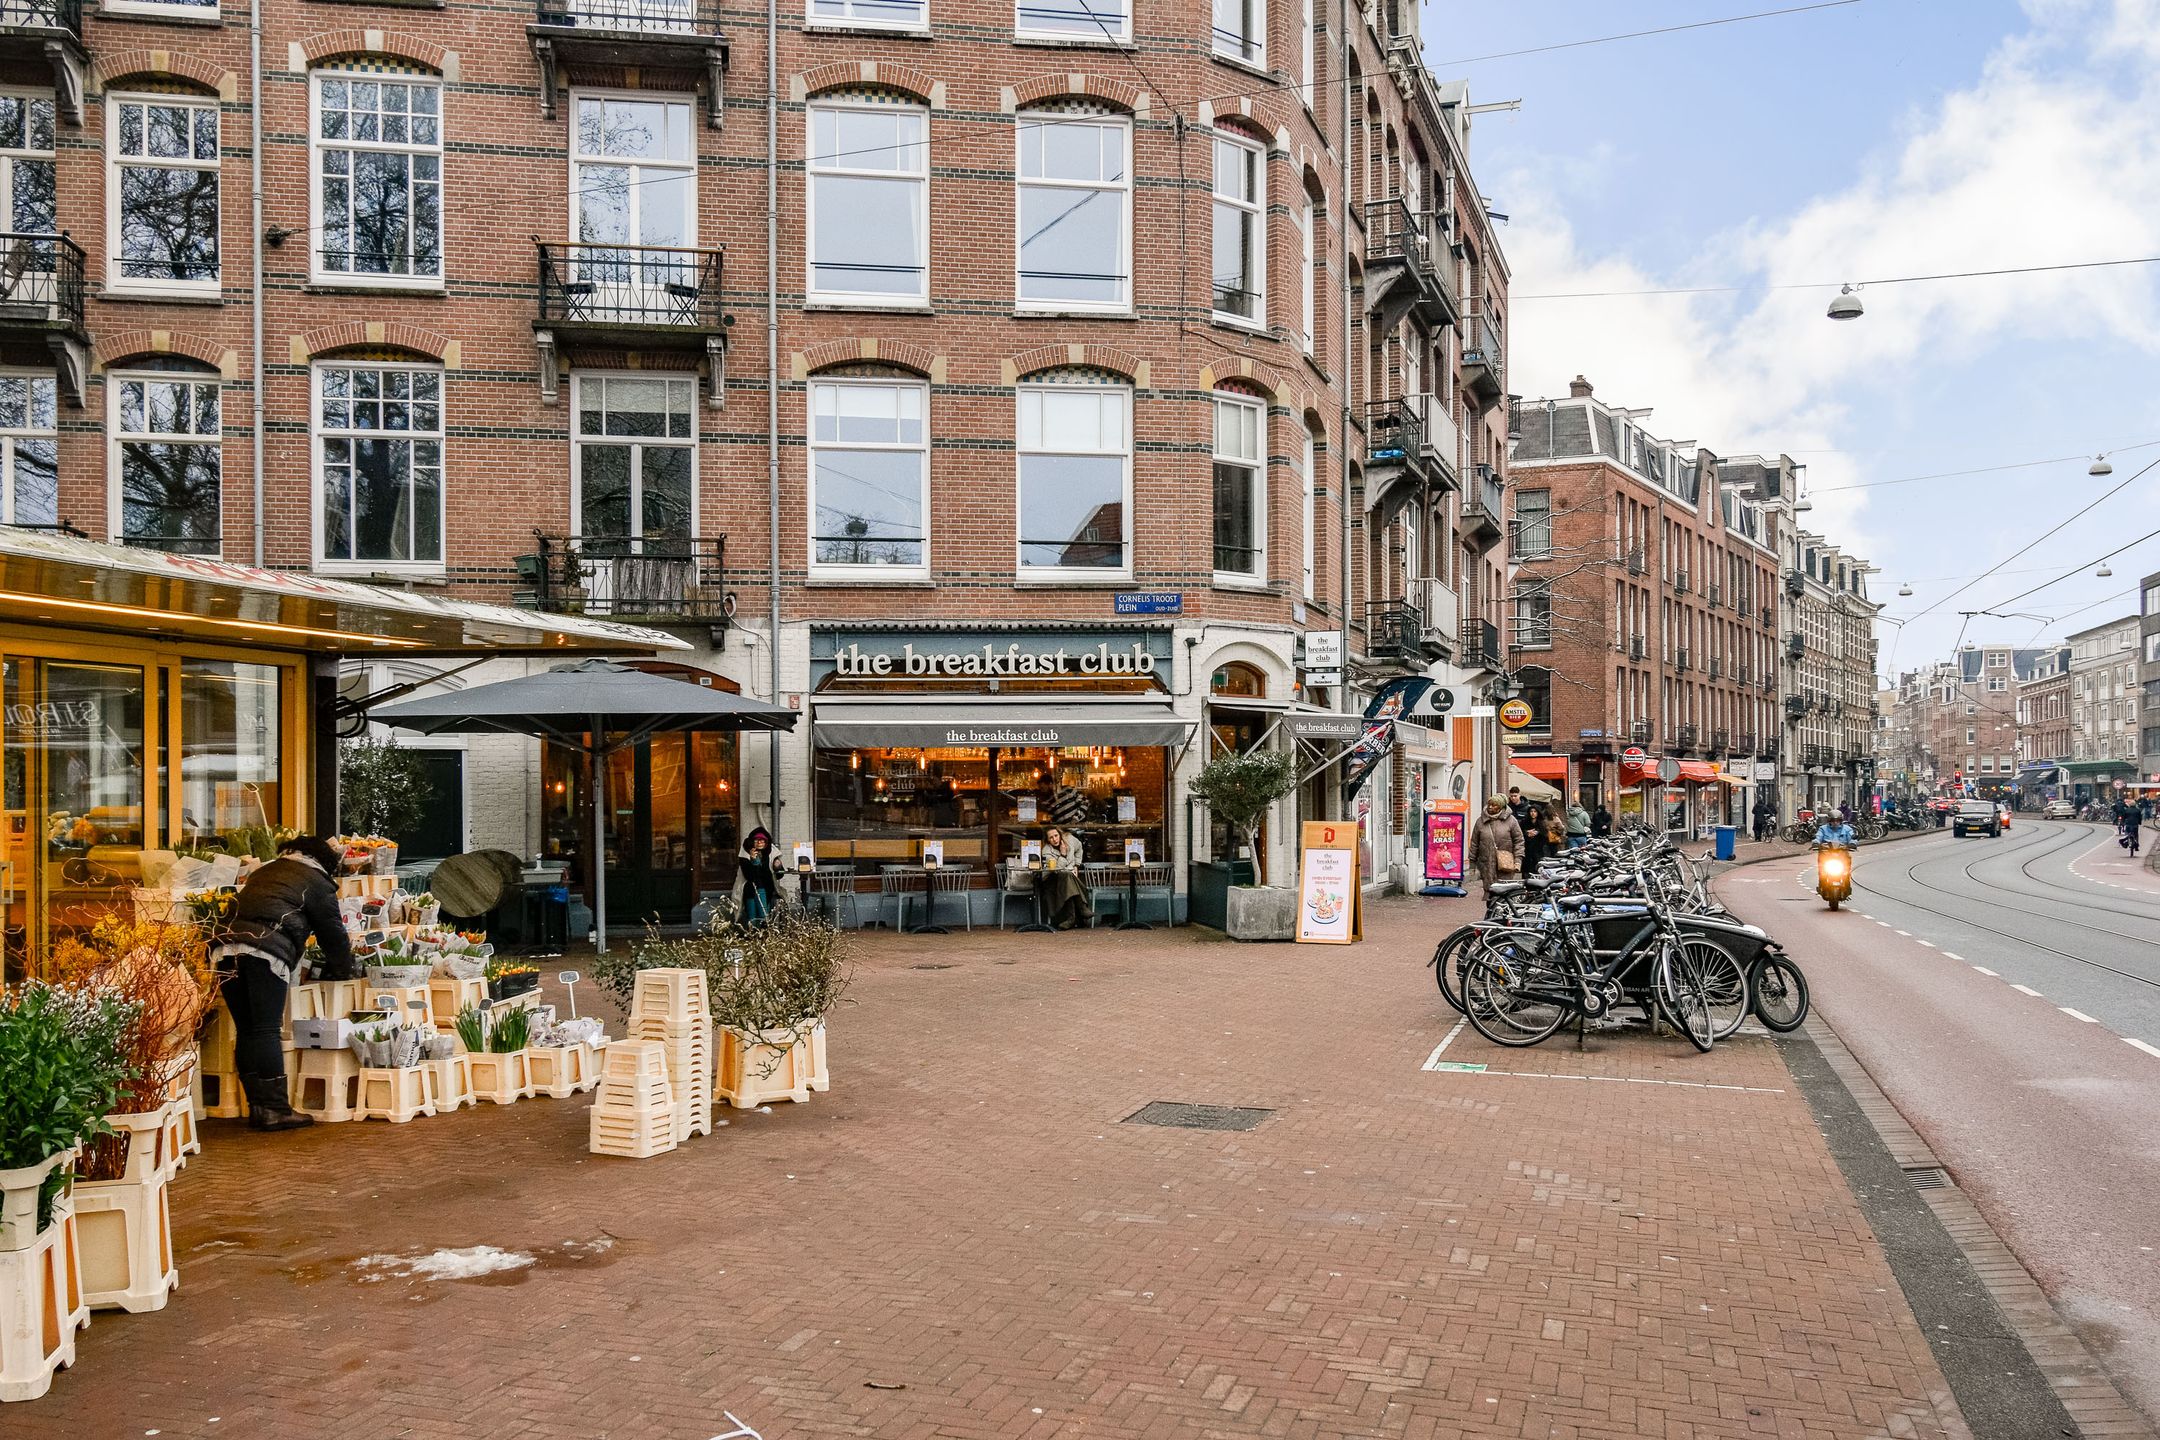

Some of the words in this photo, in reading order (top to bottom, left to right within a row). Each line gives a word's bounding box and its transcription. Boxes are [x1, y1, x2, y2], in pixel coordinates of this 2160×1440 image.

[1118, 595, 1150, 603] CORNELIS
[1152, 595, 1177, 603] TROOST
[835, 643, 892, 675] the
[903, 643, 1071, 675] breakfast
[1079, 642, 1155, 674] club
[1296, 722, 1307, 731] the
[1308, 722, 1339, 732] breakfast
[1340, 723, 1356, 732] club
[946, 730, 967, 741] the
[969, 729, 1029, 741] breakfast
[1031, 729, 1059, 741] club
[877, 766, 929, 776] breakfast
[891, 779, 916, 790] club
